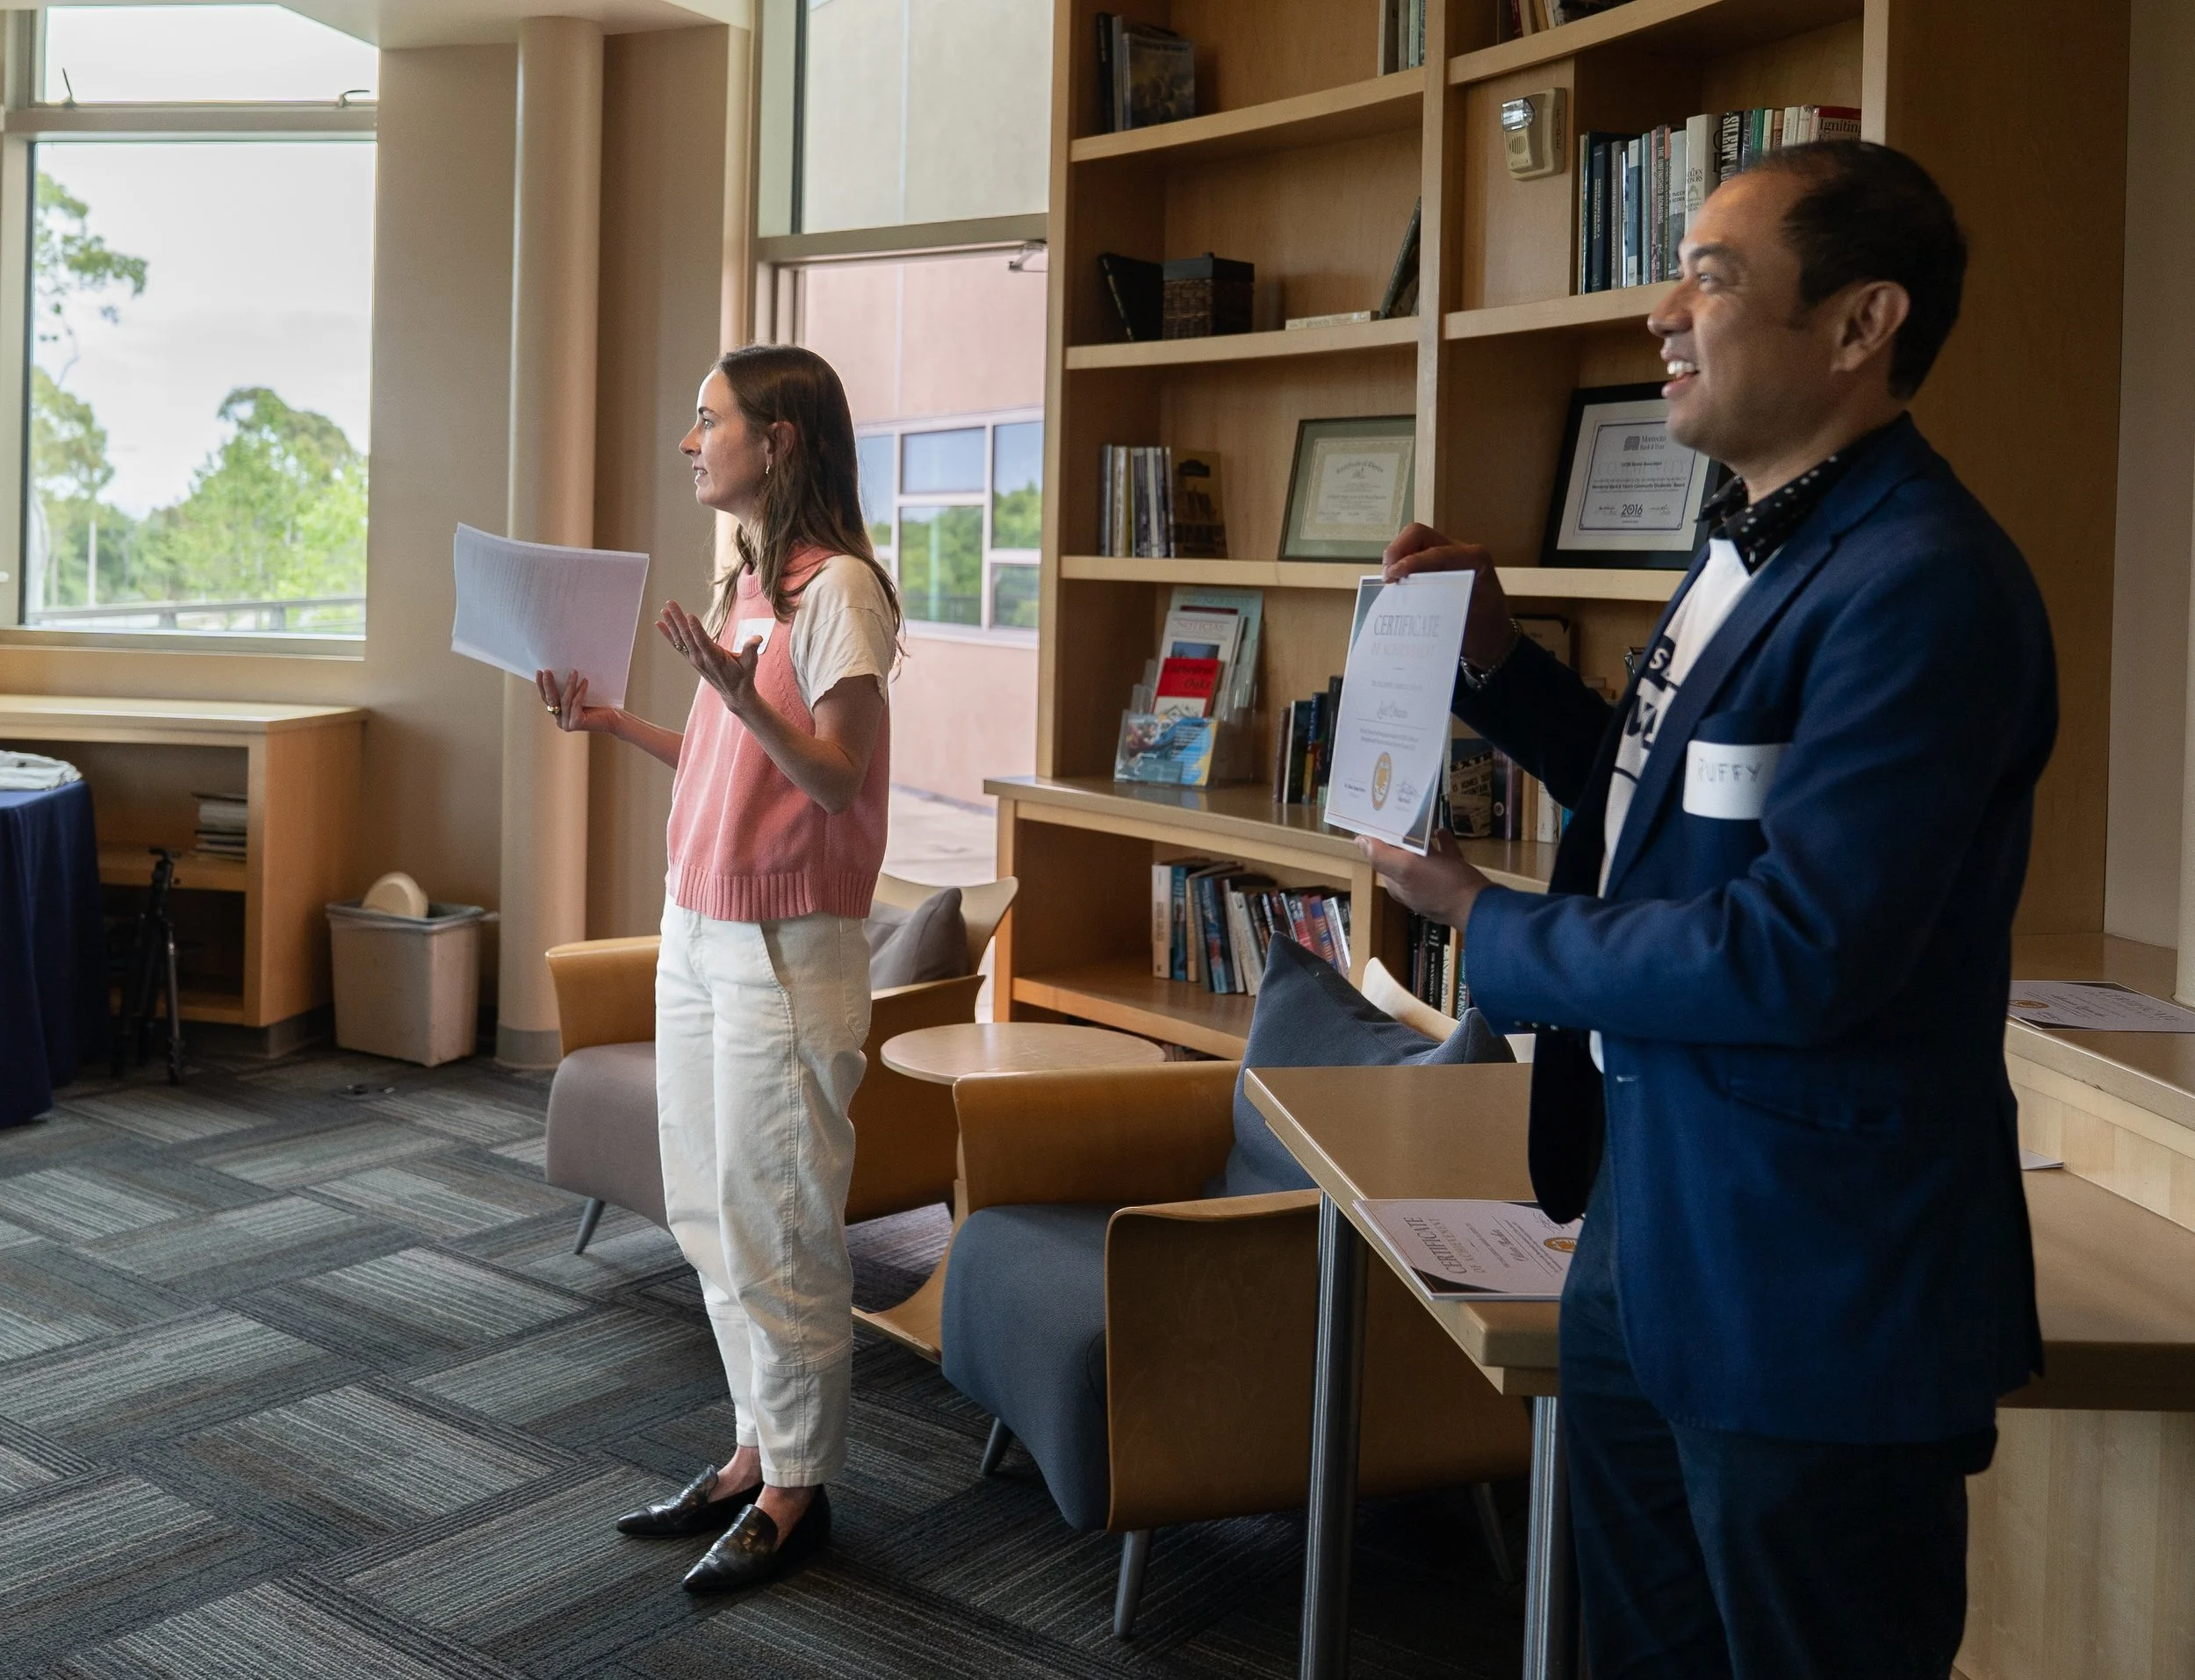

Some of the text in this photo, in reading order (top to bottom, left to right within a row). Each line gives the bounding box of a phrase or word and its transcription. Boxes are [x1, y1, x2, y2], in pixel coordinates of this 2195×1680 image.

[1721, 115, 1739, 161] SILENT
[1621, 504, 1643, 515] 2016
[1374, 614, 1440, 637] CERTIFICATE
[1697, 757, 1762, 783] PUFFY
[1403, 1217, 1467, 1274] CERTIFICATE
